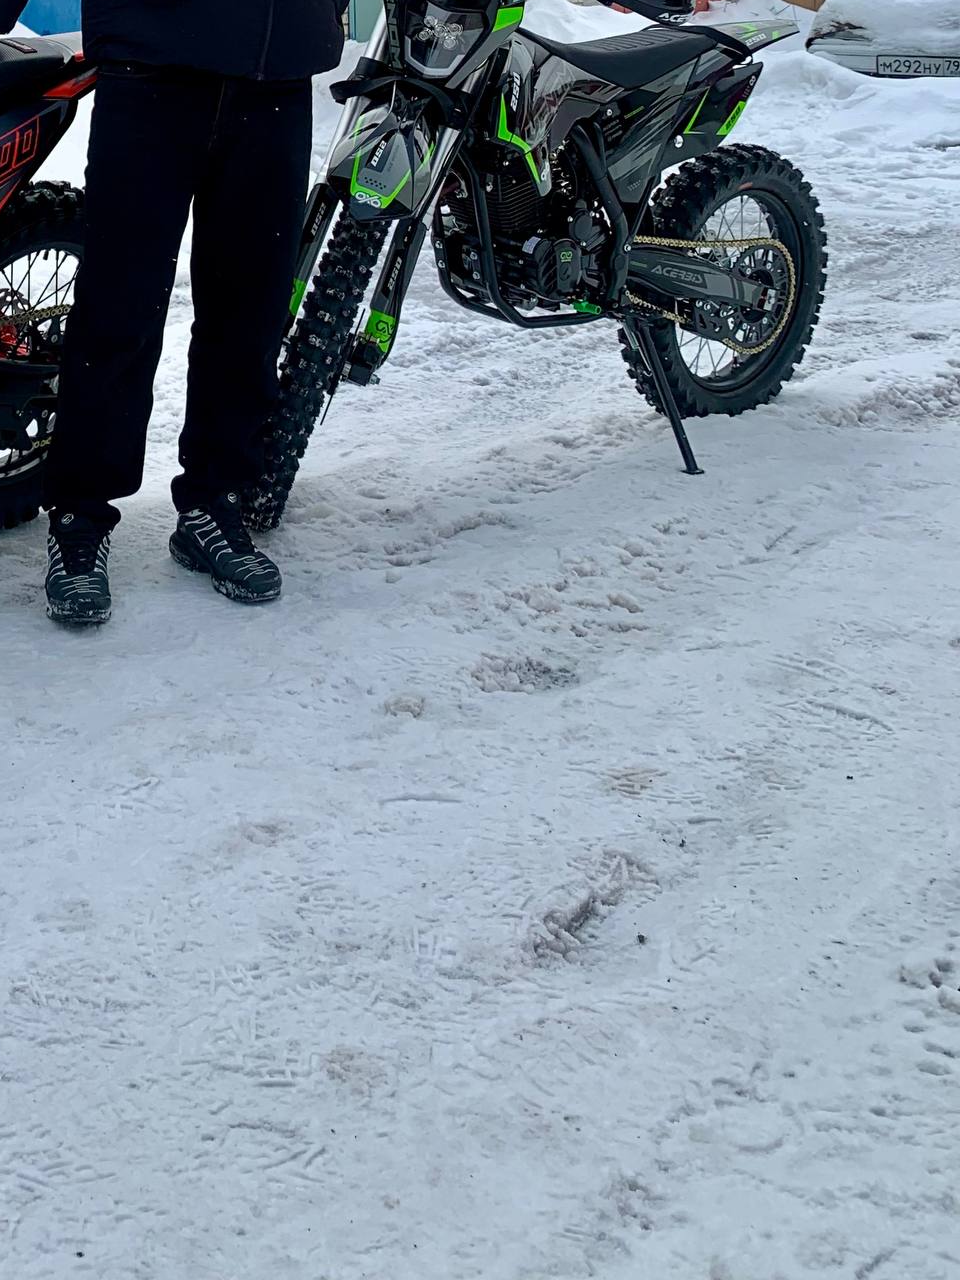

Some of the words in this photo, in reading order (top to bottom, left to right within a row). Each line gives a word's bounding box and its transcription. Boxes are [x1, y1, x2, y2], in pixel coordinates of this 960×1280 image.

[657, 12, 689, 24] ACE
[510, 71, 521, 113] 250
[370, 139, 388, 168] 250
